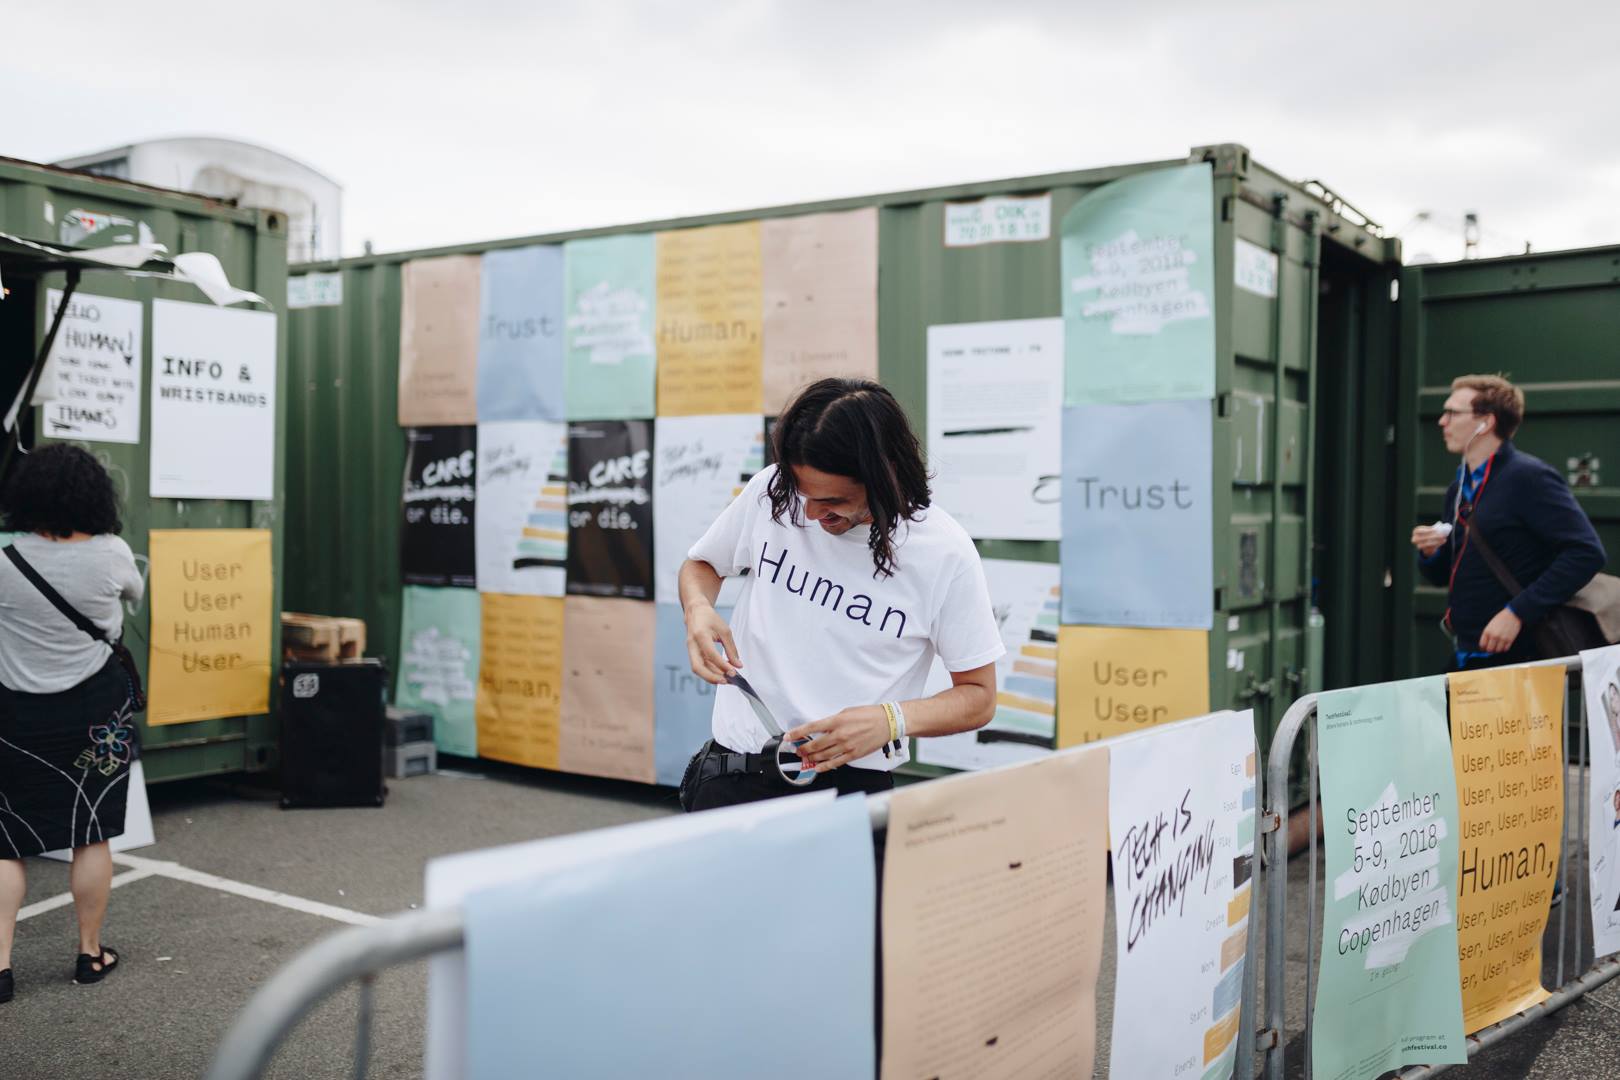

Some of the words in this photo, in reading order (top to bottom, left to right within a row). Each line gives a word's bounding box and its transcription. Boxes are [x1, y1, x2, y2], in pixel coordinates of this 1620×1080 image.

[486, 315, 556, 340] Trust
[659, 319, 757, 345] Human,
[162, 357, 223, 379] INFO
[238, 363, 252, 382] &
[160, 386, 268, 408] WRISTBANDS
[589, 450, 650, 486] CARE
[1077, 477, 1194, 510] Trust
[182, 560, 244, 582] User
[183, 591, 244, 612] User
[758, 541, 907, 639] Human
[174, 621, 252, 643] Human
[183, 652, 243, 674] User
[1093, 661, 1168, 688] User
[1094, 696, 1169, 723] User
[1460, 720, 1493, 740] User,
[1496, 716, 1526, 736] User,
[1526, 713, 1554, 731] User,
[1462, 753, 1495, 774] User,
[1498, 748, 1528, 767] User,
[1530, 743, 1557, 762] User,
[1463, 786, 1495, 807] User,
[1498, 779, 1528, 800] User,
[1531, 773, 1559, 793] User,
[1346, 791, 1441, 836] September
[1463, 820, 1495, 840] User,
[1498, 811, 1528, 832] User,
[1530, 804, 1558, 823] User,
[1118, 811, 1169, 890] TECH
[1173, 788, 1192, 841] IS
[1353, 840, 1388, 873] 5-9,
[1399, 823, 1438, 859] 2018
[1127, 818, 1215, 954] CHANGING
[1460, 842, 1554, 897] Human,
[1358, 869, 1430, 911] Kødbyen
[1457, 911, 1488, 932] User,
[1490, 900, 1520, 921] User,
[1521, 888, 1549, 909] User,
[1338, 899, 1440, 956] Copenhagen
[1459, 942, 1484, 961] ser,
[1487, 929, 1515, 951] User,
[1517, 918, 1543, 939] User,
[1462, 972, 1479, 990] er,
[1482, 960, 1510, 982] User,
